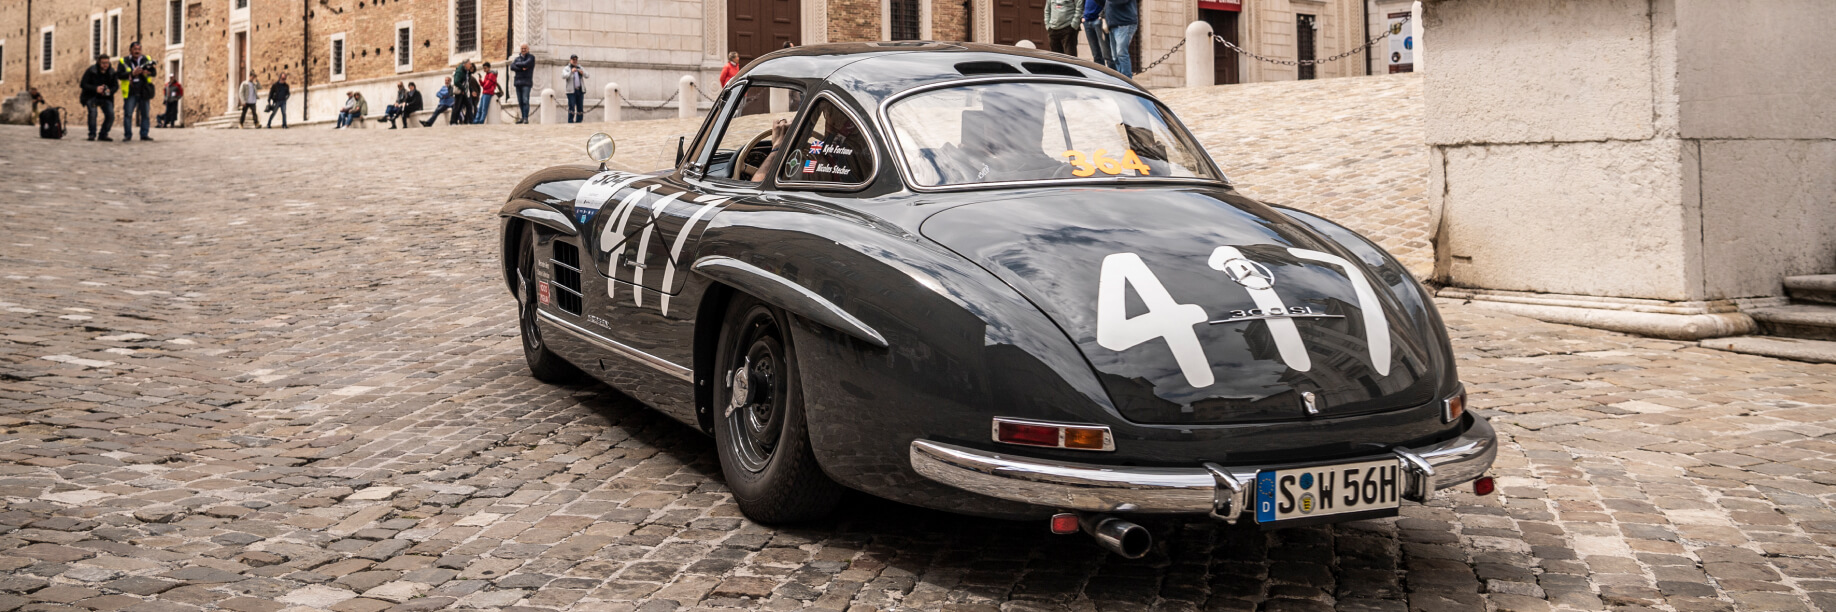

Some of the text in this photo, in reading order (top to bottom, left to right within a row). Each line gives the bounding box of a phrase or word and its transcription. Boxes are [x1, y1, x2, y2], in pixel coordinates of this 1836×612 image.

[823, 144, 853, 156] Kyle Fortune
[816, 163, 851, 175] Nicolas Stecher
[1062, 148, 1151, 177] 364
[601, 184, 733, 317] 417
[1097, 246, 1392, 389] 417
[1230, 307, 1284, 318] 300
[1278, 465, 1397, 514] S W 56H
[1262, 501, 1271, 513] D
